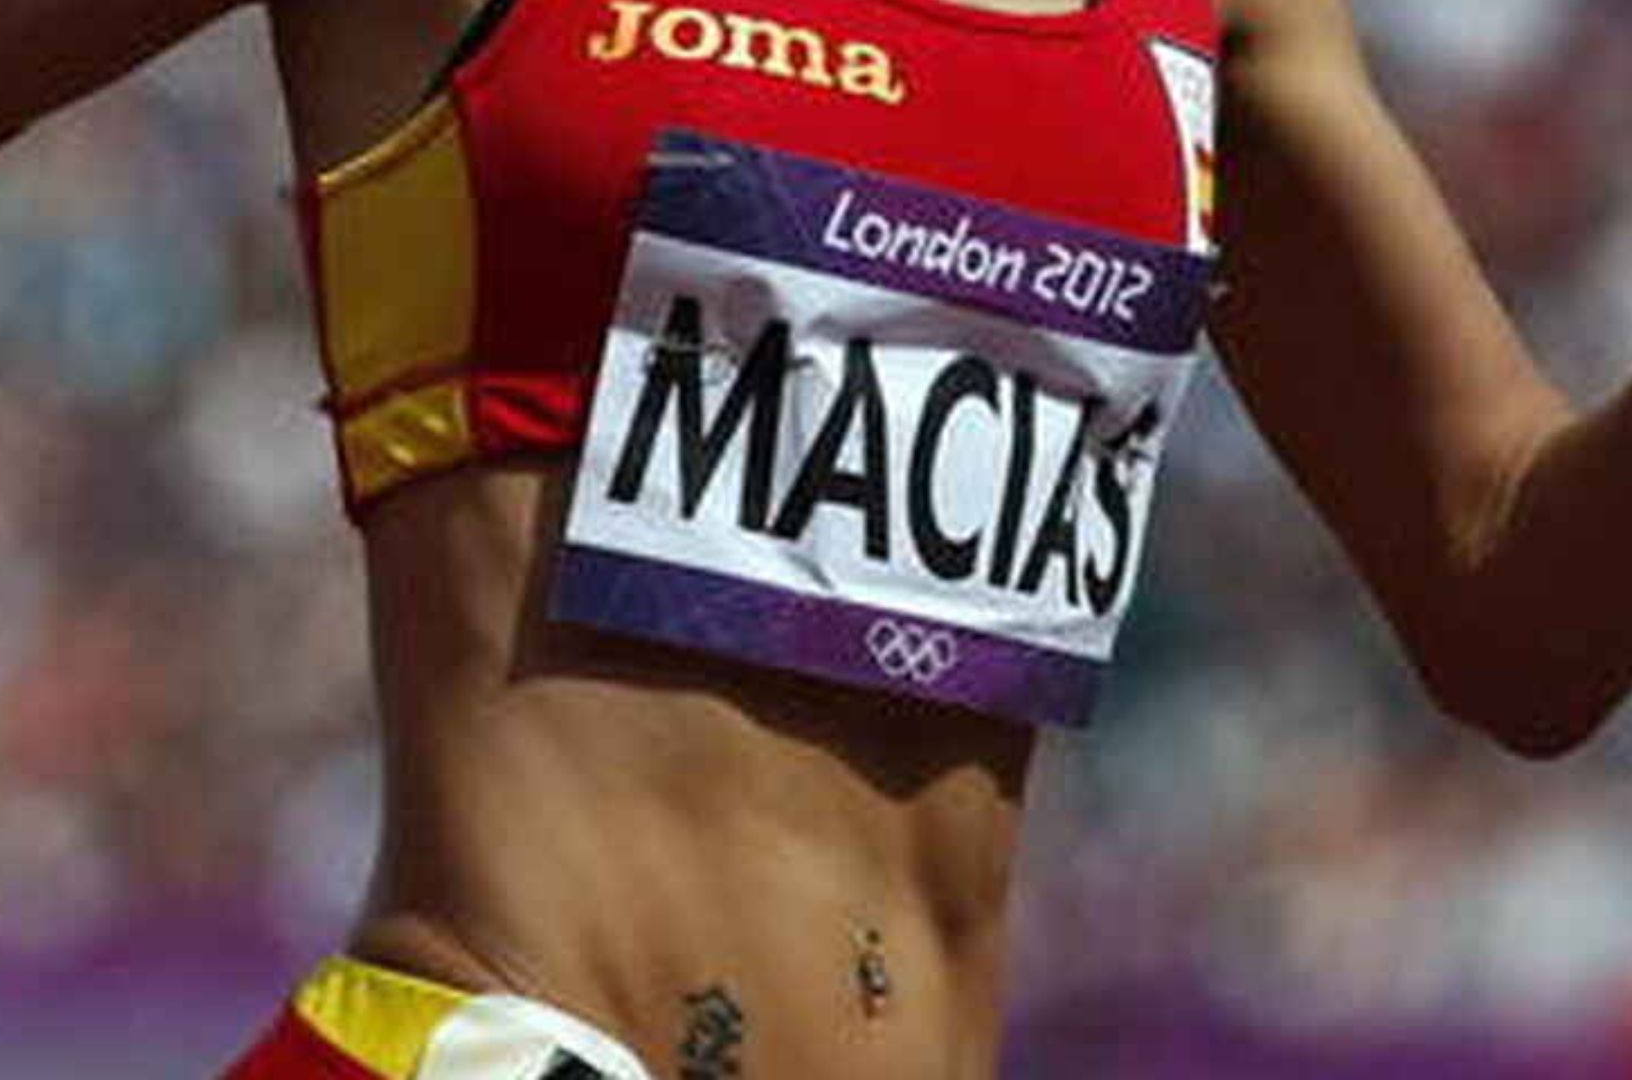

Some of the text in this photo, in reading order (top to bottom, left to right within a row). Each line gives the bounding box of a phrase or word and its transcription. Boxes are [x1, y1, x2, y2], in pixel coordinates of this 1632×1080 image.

[823, 189, 1154, 320] London 2012
[606, 296, 1160, 617] MACIAS
